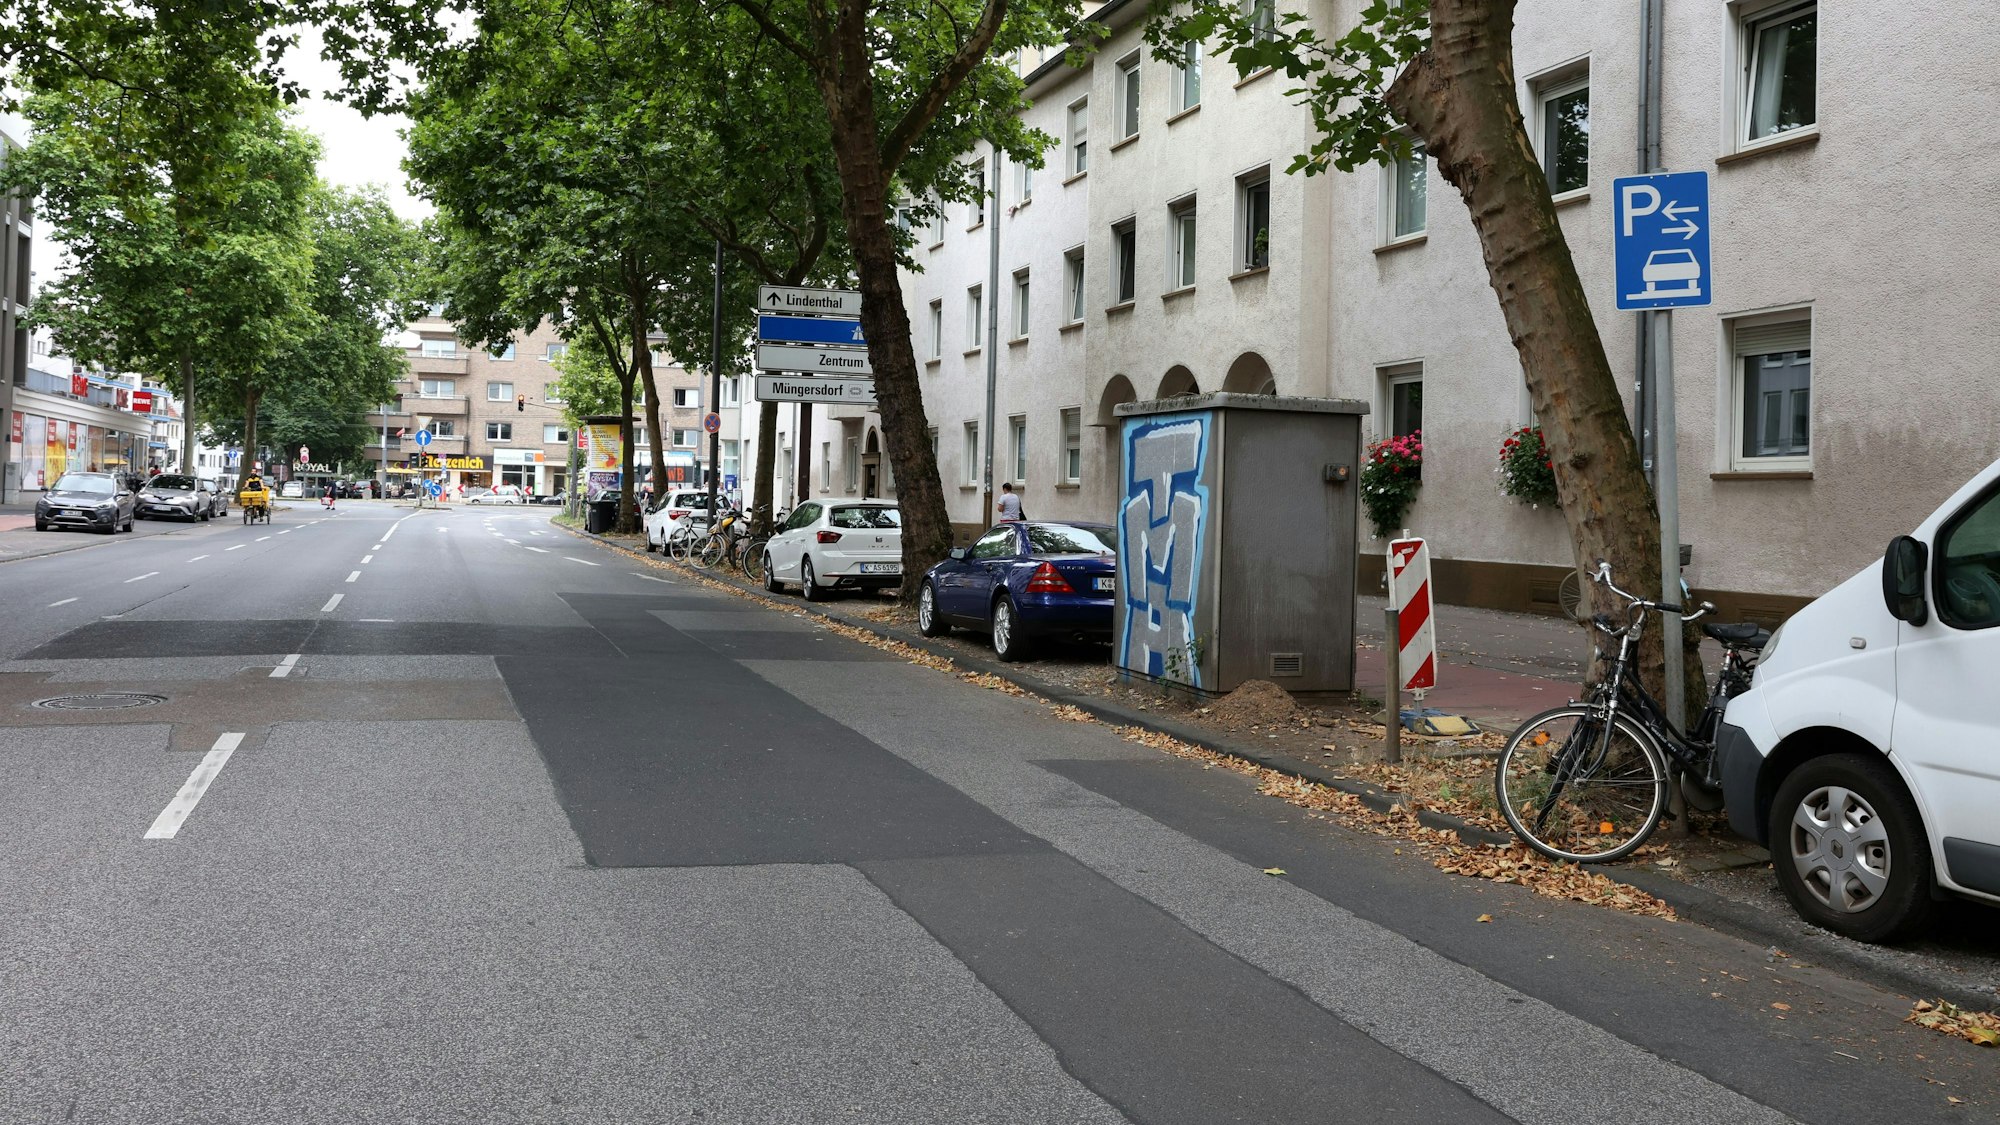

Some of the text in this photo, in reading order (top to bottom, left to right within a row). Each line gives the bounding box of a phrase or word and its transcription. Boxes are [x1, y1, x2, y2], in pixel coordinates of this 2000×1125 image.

[1622, 184, 1661, 236] P
[786, 293, 842, 308] Lindenthal
[819, 354, 864, 368] Zentrum
[772, 382, 843, 397] Müngersdorf
[133, 397, 151, 405] REWE
[292, 463, 332, 472] ROYAL
[425, 455, 484, 469] ezenich
